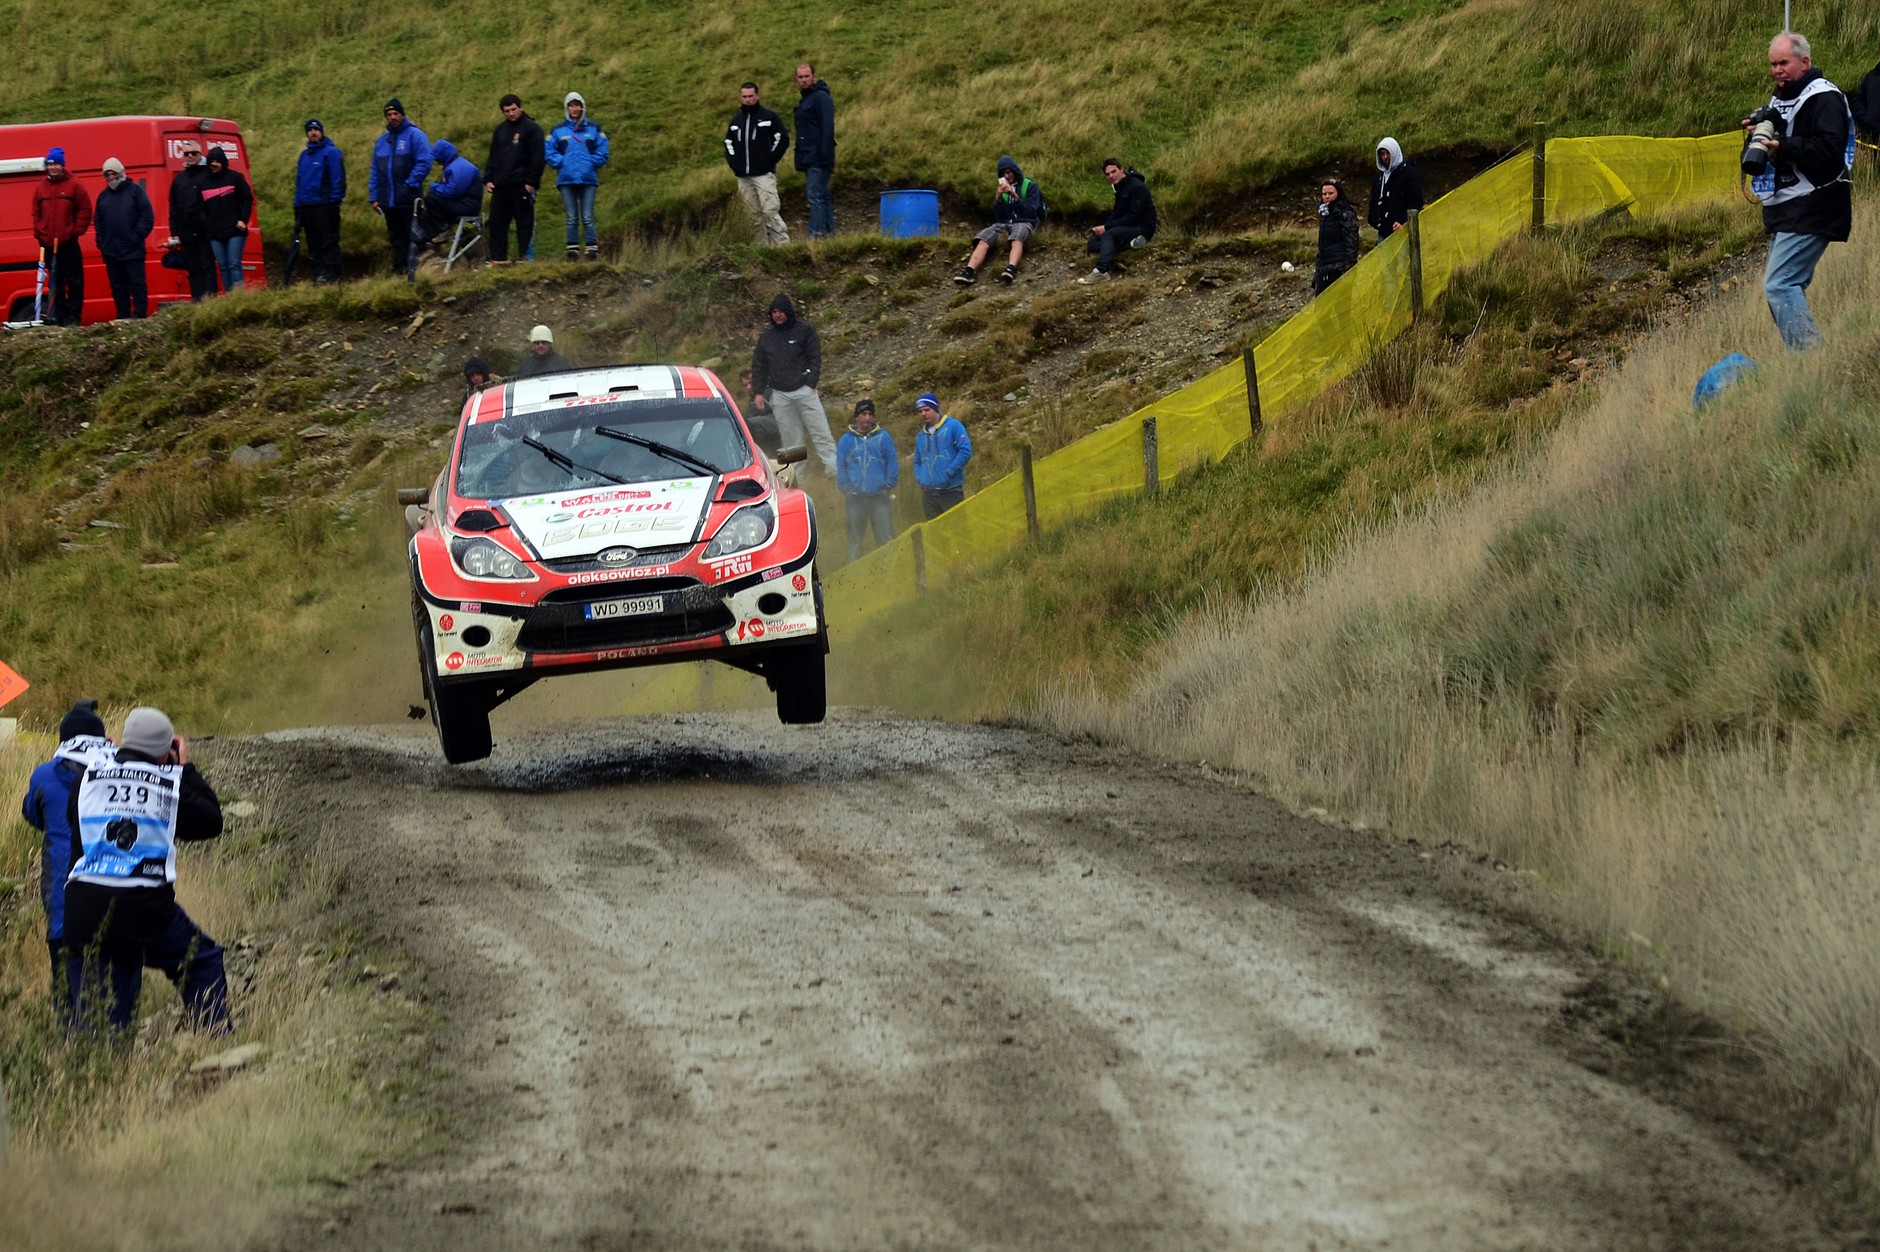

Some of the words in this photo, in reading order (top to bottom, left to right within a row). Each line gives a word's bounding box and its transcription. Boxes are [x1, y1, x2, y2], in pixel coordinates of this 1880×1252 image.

[167, 139, 188, 159] IC
[577, 501, 672, 519] Castrol
[542, 515, 688, 547] EDGE
[606, 552, 628, 561] Ford
[568, 566, 670, 585] oleksowicz.pl
[711, 554, 752, 580] TRW
[594, 604, 619, 617] WD
[623, 599, 661, 613] 99991
[767, 623, 807, 633] INTEGRATOR
[466, 656, 503, 666] INTEGRATOR
[597, 647, 658, 660] POLAND
[122, 769, 149, 783] RALLY
[107, 785, 149, 804] 239
